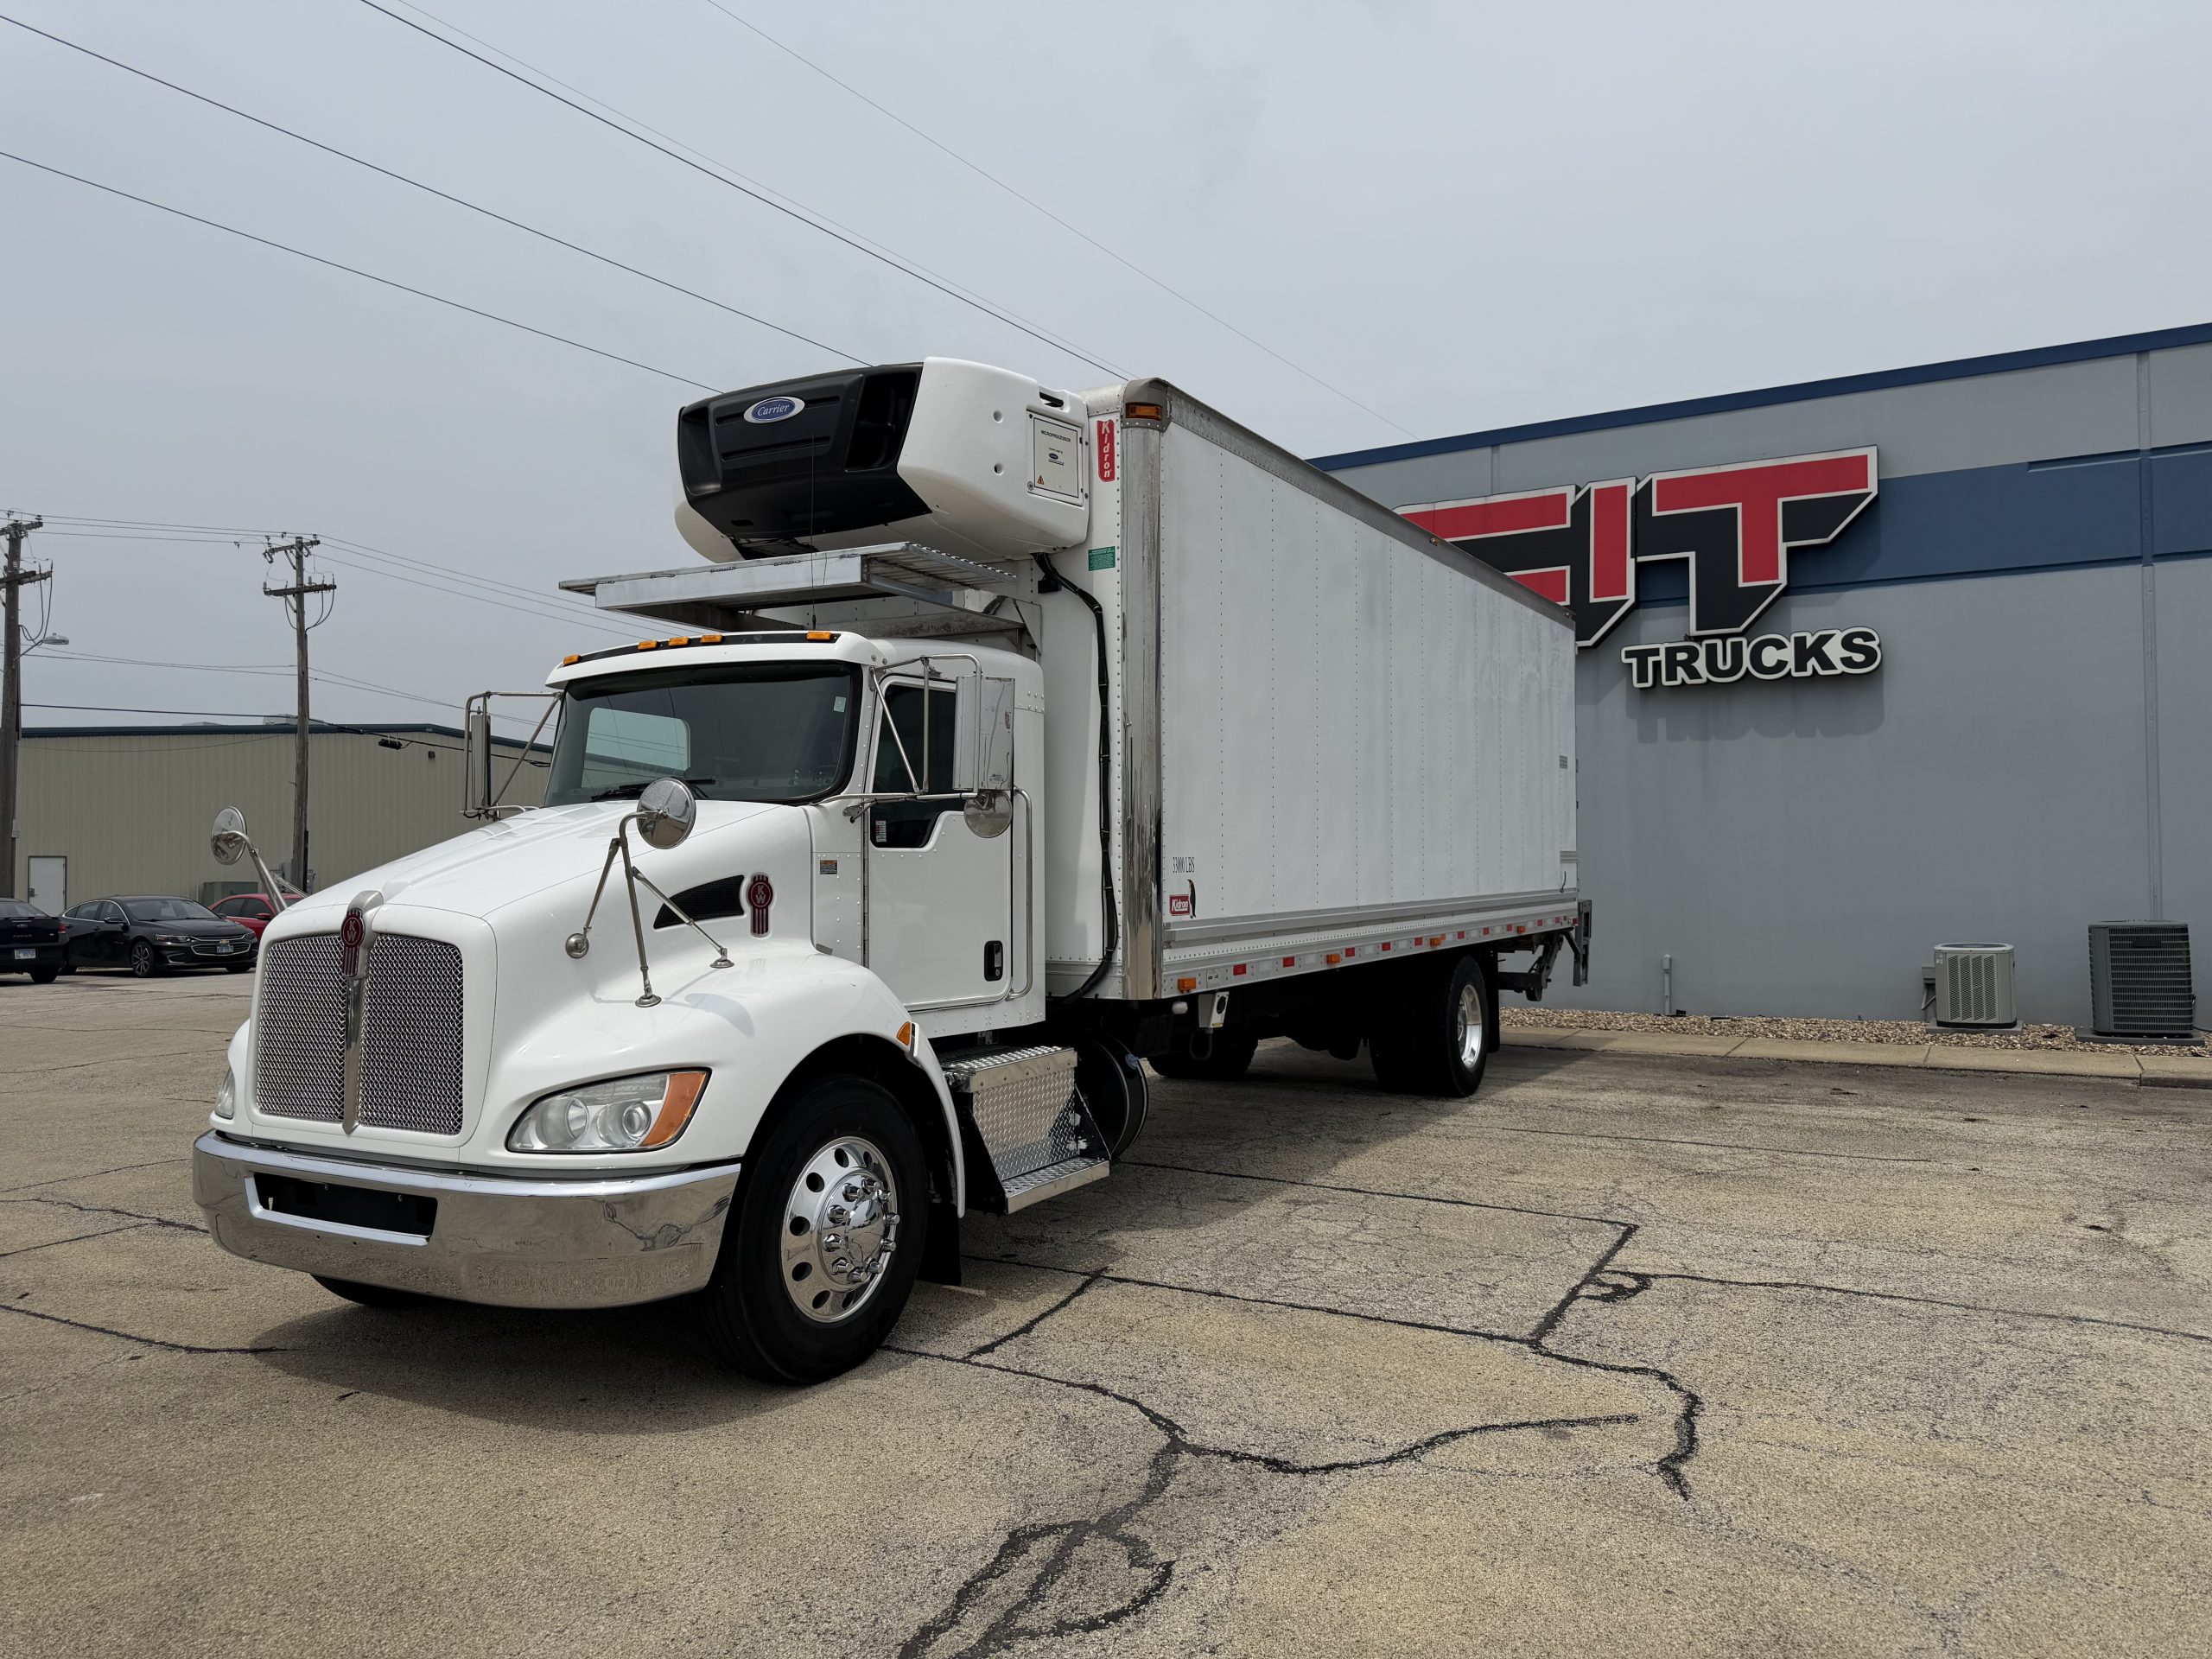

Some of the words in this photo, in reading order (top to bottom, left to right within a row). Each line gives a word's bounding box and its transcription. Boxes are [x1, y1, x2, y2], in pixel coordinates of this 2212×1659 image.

[757, 404, 790, 416] Carrier
[1040, 429, 1071, 442] MICROPROCESSOR
[1101, 421, 1112, 478] Kidron
[1622, 627, 1882, 688] TRUCKS
[1185, 856, 1195, 873] LBS
[1171, 899, 1189, 912] Kidron
